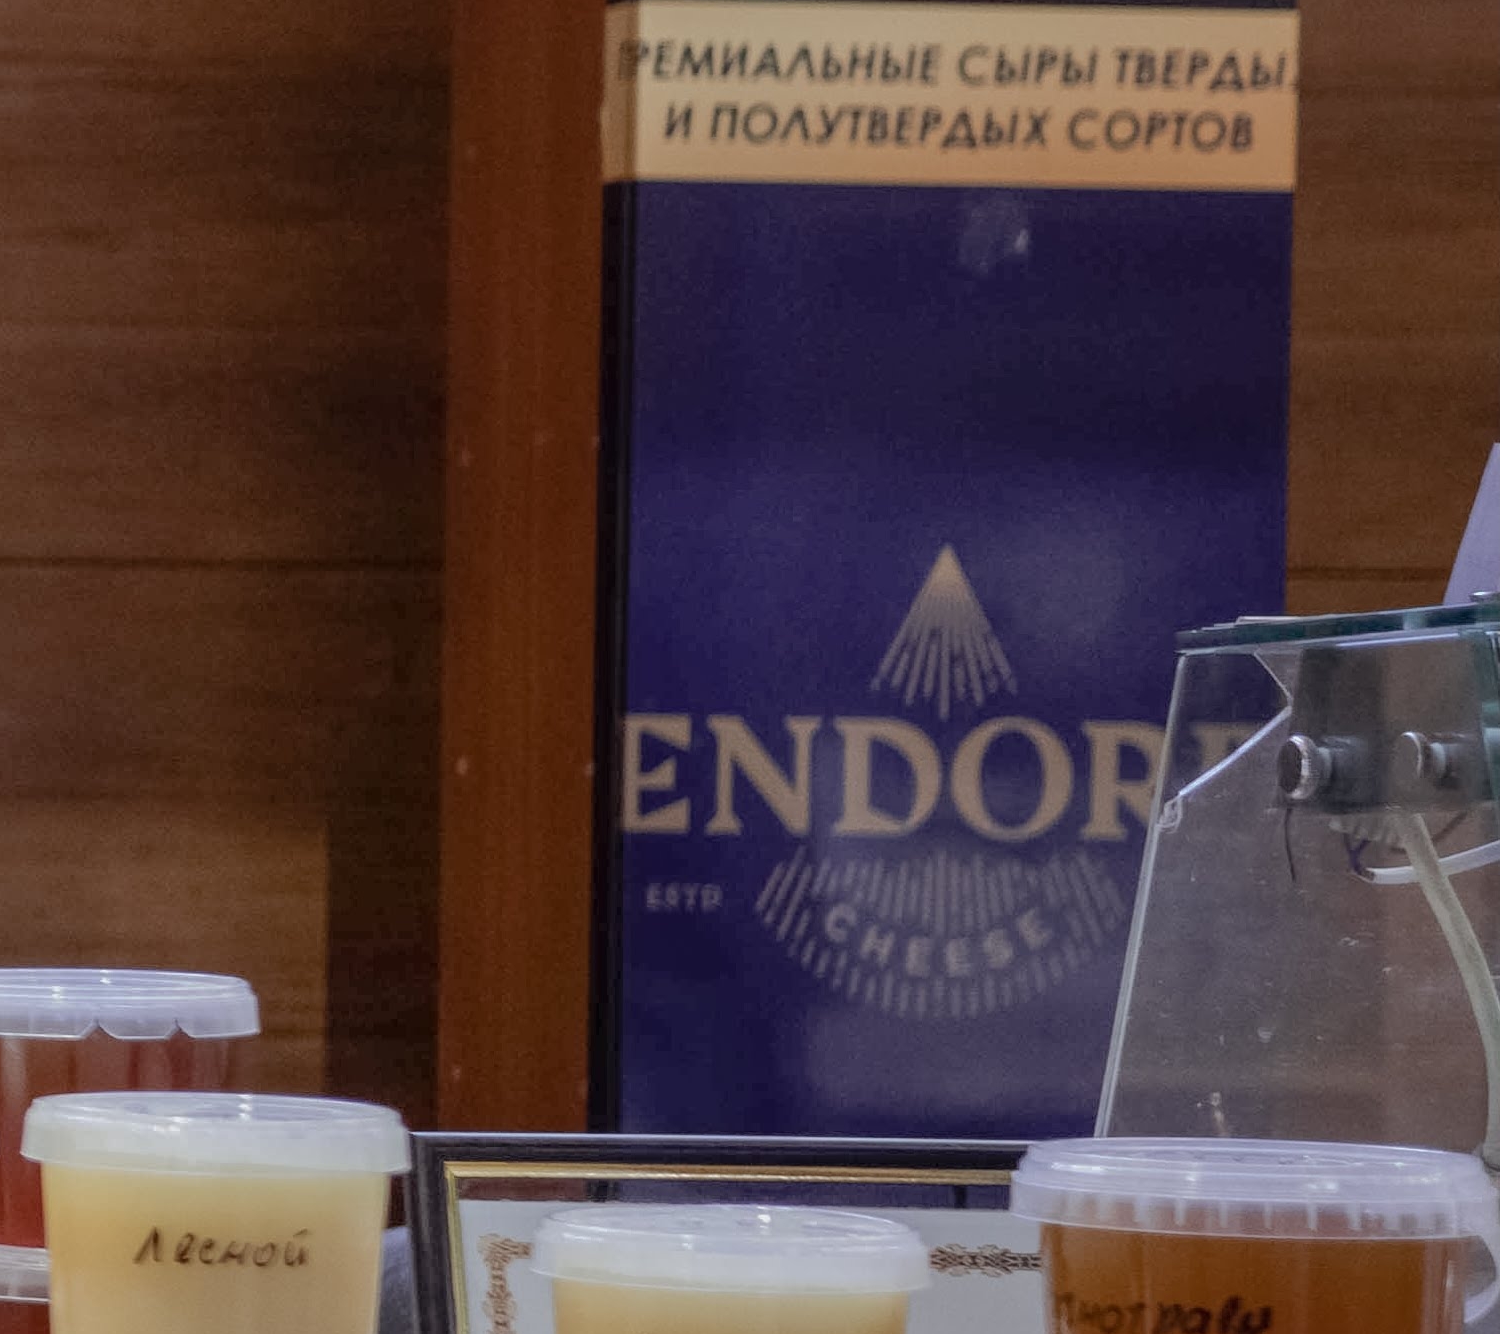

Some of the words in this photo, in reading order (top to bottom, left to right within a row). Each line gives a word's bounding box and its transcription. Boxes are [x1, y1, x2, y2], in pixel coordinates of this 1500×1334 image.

[618, 38, 938, 88] РЕМИАЛЬНЫЕ
[959, 43, 1100, 90] СЫРЫ
[1115, 47, 1298, 96] ТВЕРДЫ
[663, 104, 694, 141] И
[709, 103, 1051, 152] ПОЛУТВЕРДЫХ
[1068, 107, 1256, 155] СОРТОВ
[823, 905, 1054, 979] CHEESE
[132, 1223, 313, 1269] Лесной
